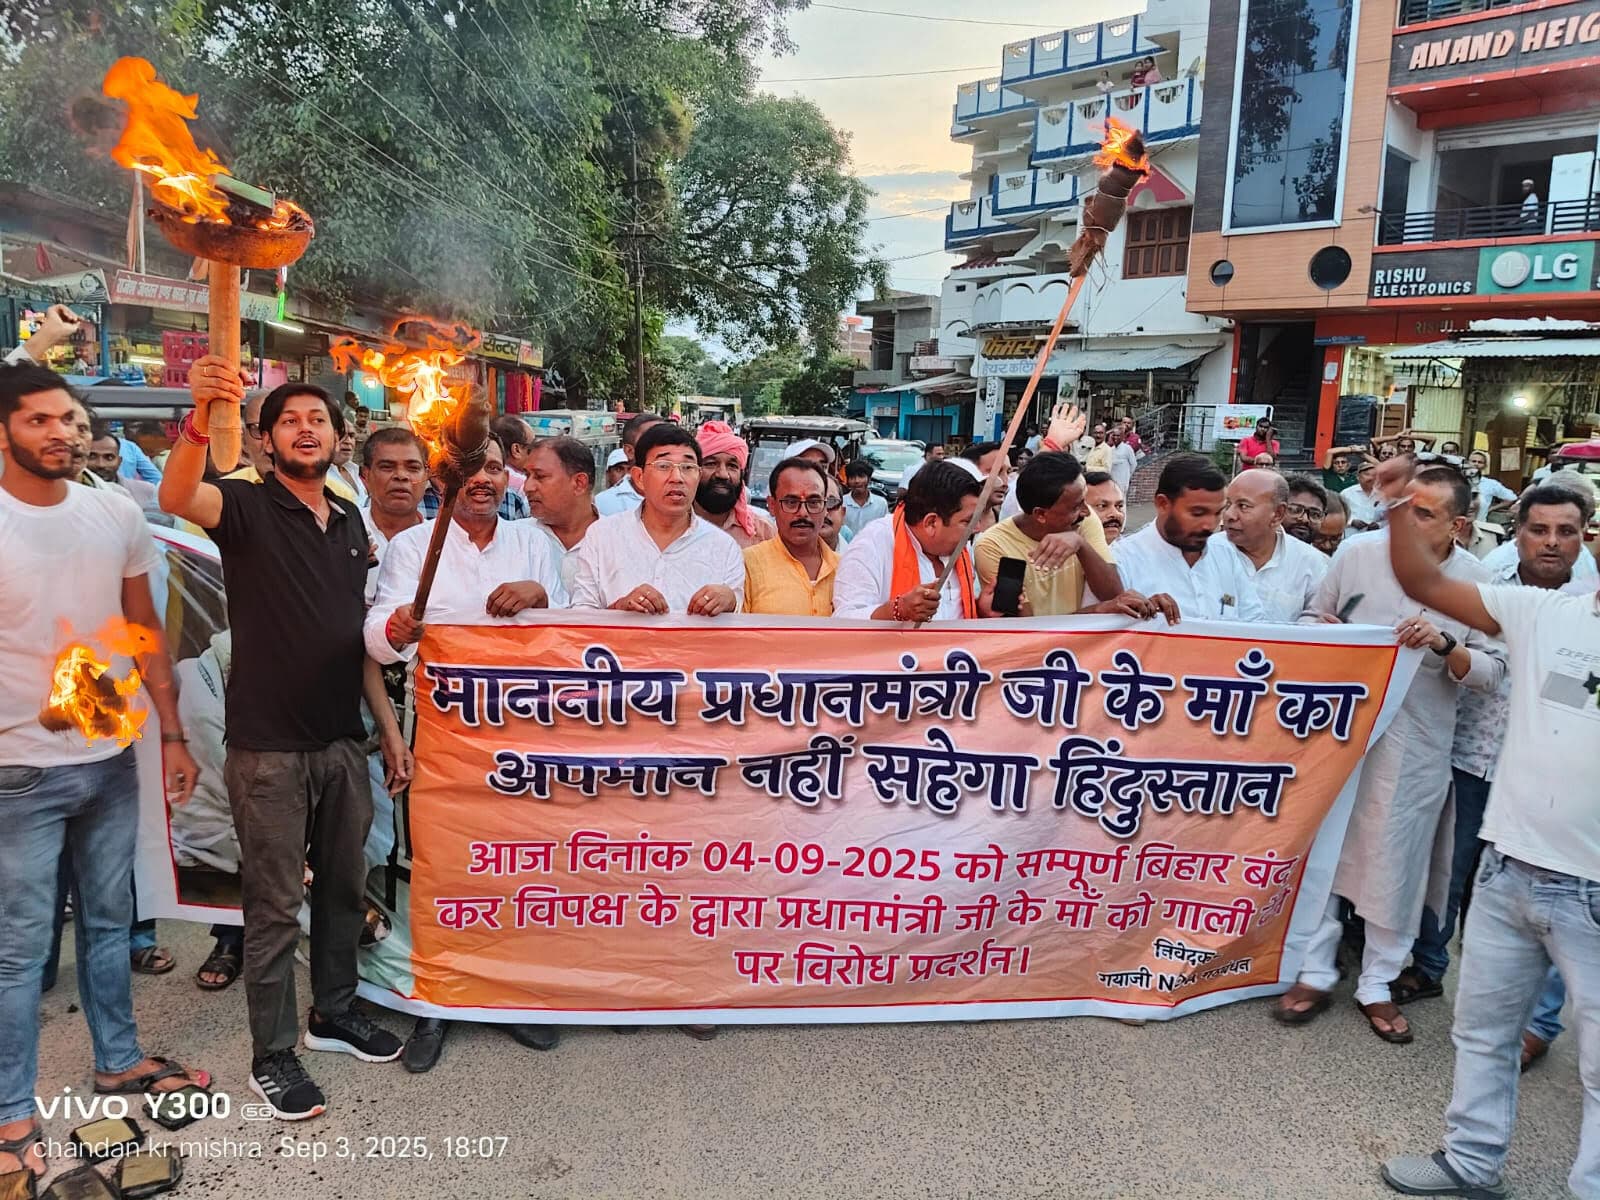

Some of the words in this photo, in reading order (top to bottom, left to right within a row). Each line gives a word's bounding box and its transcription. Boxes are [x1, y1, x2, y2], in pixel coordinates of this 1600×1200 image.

[1409, 30, 1515, 70] ANAND
[1520, 12, 1600, 53] HEIG
[1374, 281, 1472, 297] ELECTRONICS
[1375, 268, 1426, 284] RISHU
[1533, 252, 1579, 281] LG
[427, 646, 684, 724] माननीय
[696, 650, 991, 724] प्रधानमंत्री
[1002, 650, 1091, 726] जी
[1101, 650, 1174, 729] के
[1184, 650, 1272, 734] माँ
[1276, 684, 1367, 738] का
[488, 751, 727, 797] अपमान
[739, 735, 855, 805] नहीं
[863, 728, 1038, 813] सहेगा
[1049, 738, 1294, 836] हिंदुस्तान
[470, 842, 556, 874] आज
[566, 832, 692, 872] दिनांक
[704, 841, 940, 881] 04-09-2025
[954, 844, 1007, 882] को
[1016, 845, 1129, 892] सम्पूर्ण
[1137, 843, 1236, 884] बिहार
[1244, 852, 1297, 888] बंद
[437, 899, 502, 928] कर
[514, 886, 628, 927] विपक्ष
[639, 885, 680, 926] के
[690, 896, 767, 937] द्वारा
[777, 895, 946, 934] प्रधानमंत्री
[956, 895, 999, 930] जी
[1008, 890, 1046, 925] के
[1055, 888, 1102, 928] माँ
[1108, 893, 1154, 930] को
[1164, 899, 1255, 935] गाली
[735, 952, 784, 983] पर
[794, 943, 899, 984] विरोध
[1099, 968, 1151, 987] गयाजी
